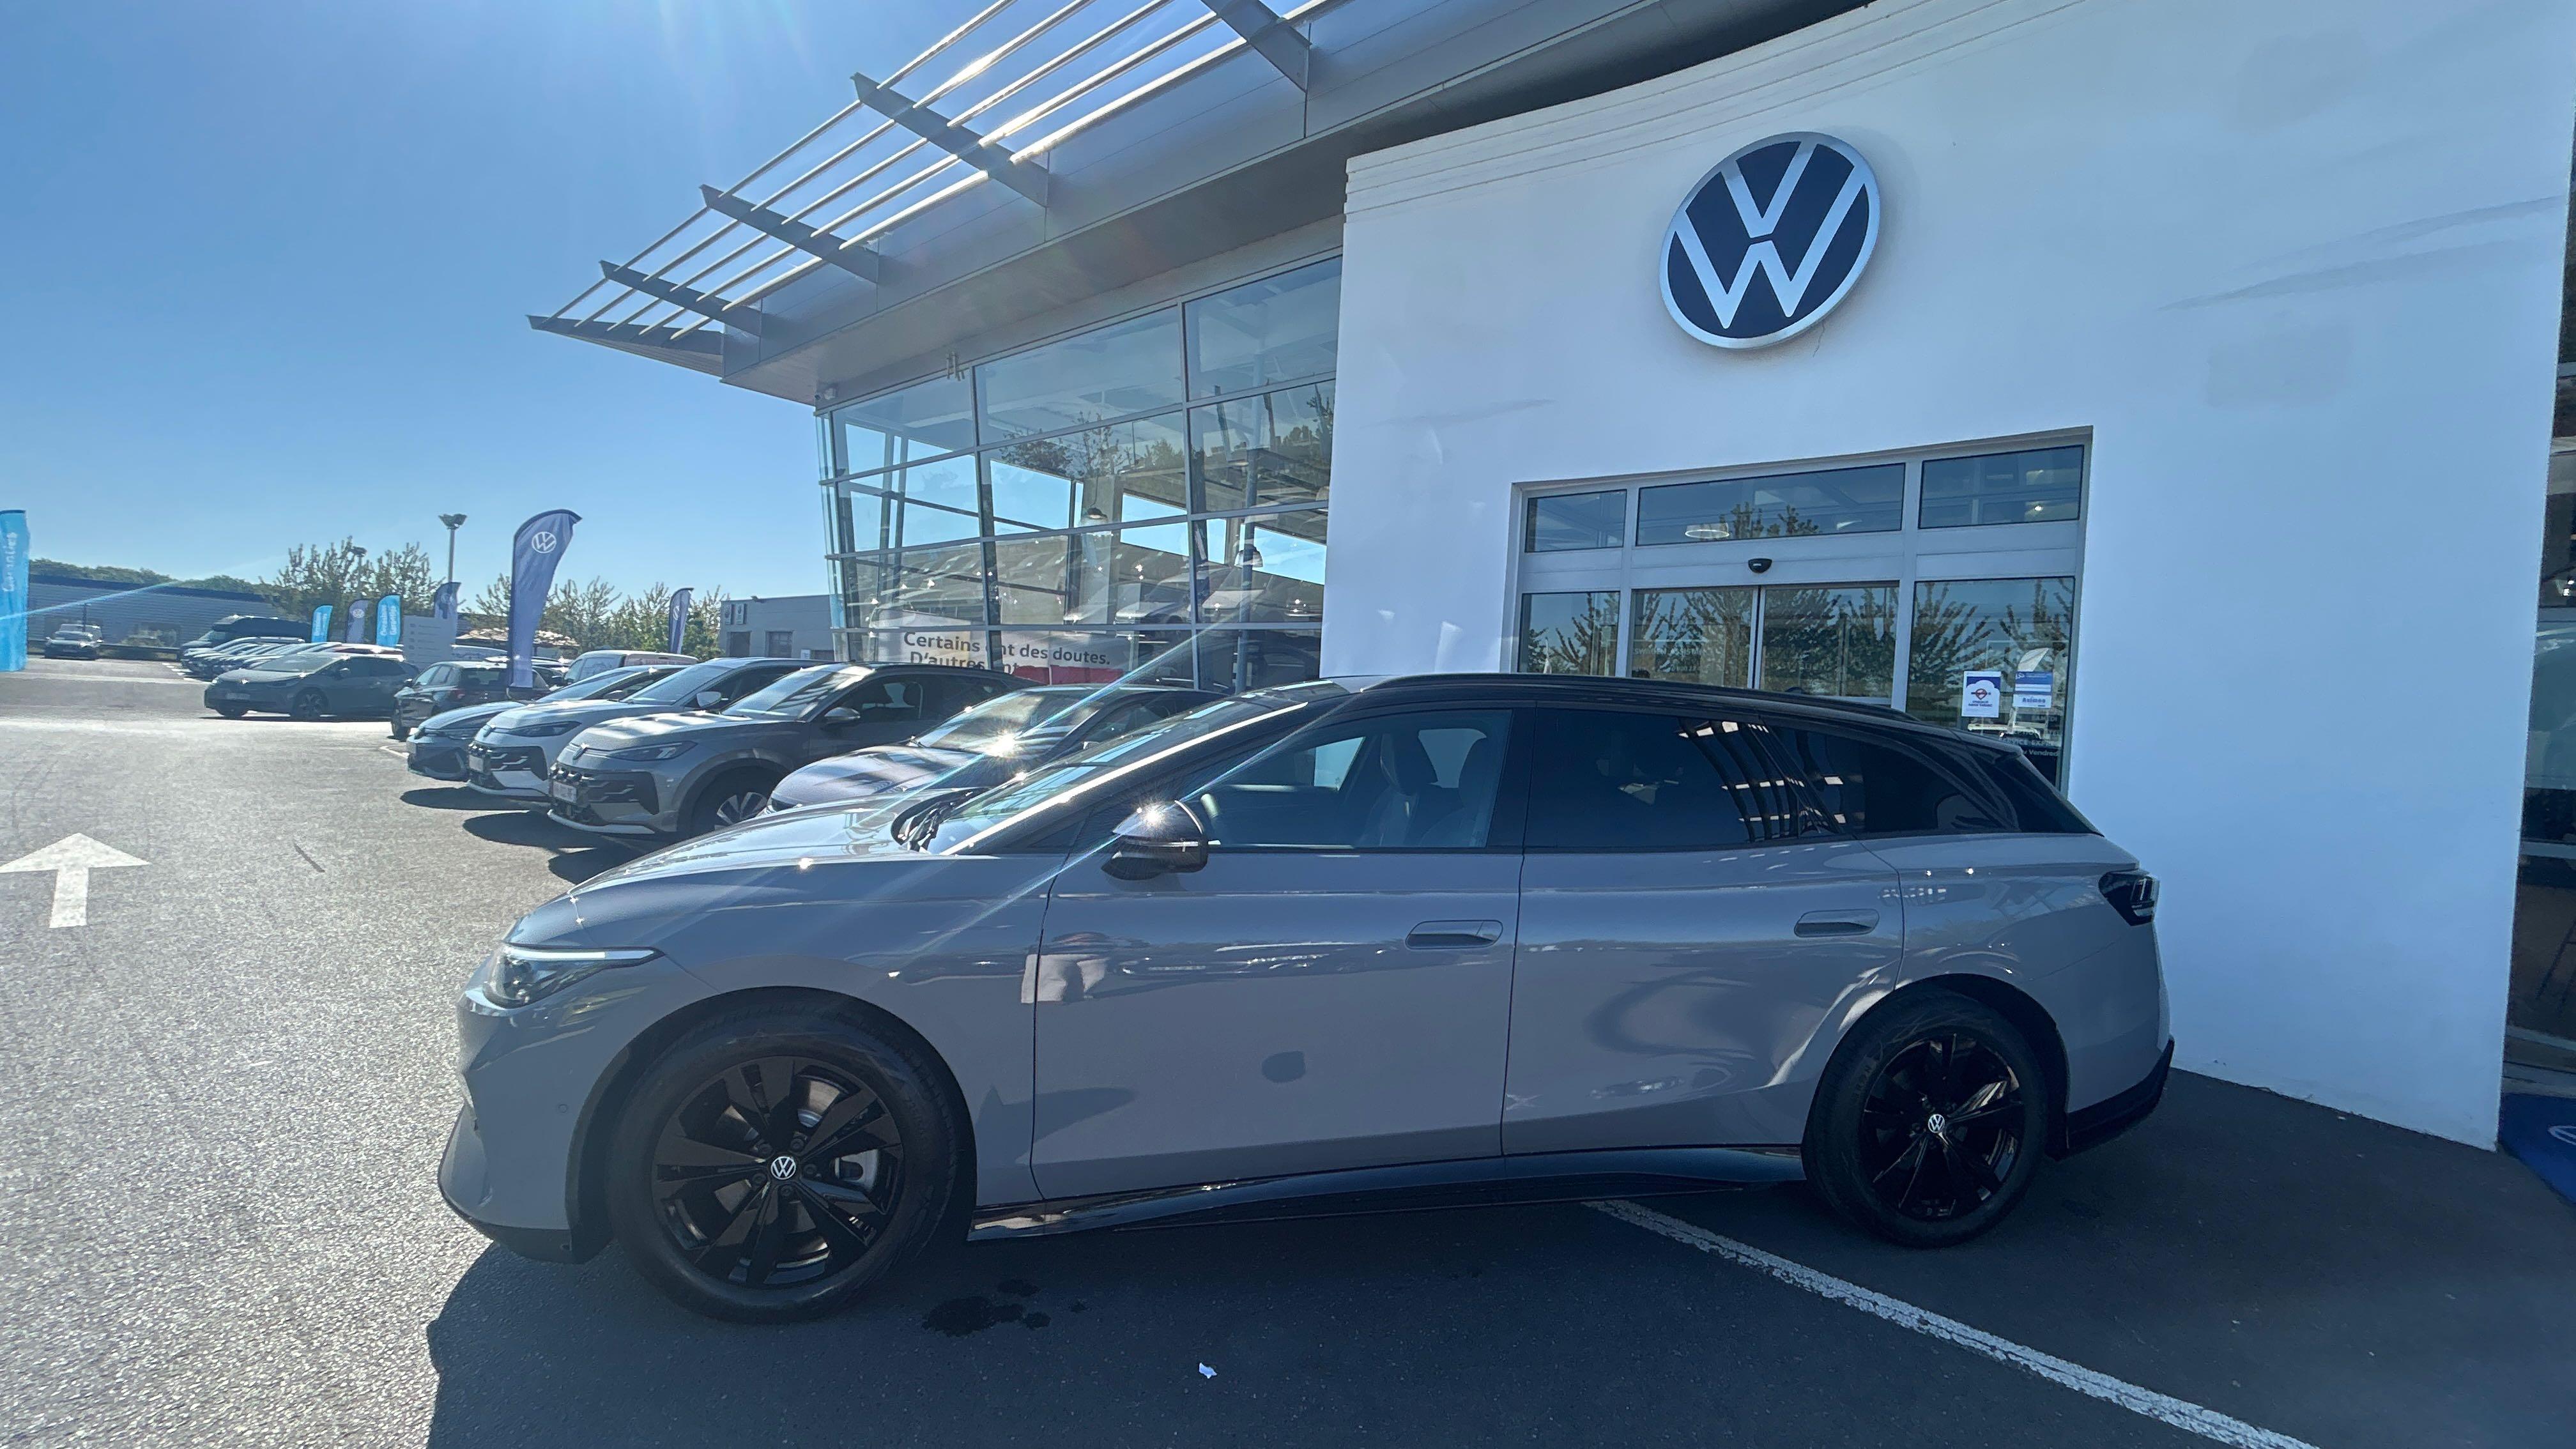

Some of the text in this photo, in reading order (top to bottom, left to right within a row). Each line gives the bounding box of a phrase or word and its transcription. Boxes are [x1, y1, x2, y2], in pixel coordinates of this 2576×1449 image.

[1659, 132, 1880, 349] VW
[532, 532, 556, 554] VW
[903, 631, 981, 652] Certains
[1020, 644, 1048, 659] des
[1053, 647, 1110, 665] doutes.
[1928, 1114, 1945, 1133] VW
[770, 1156, 796, 1180] VW
